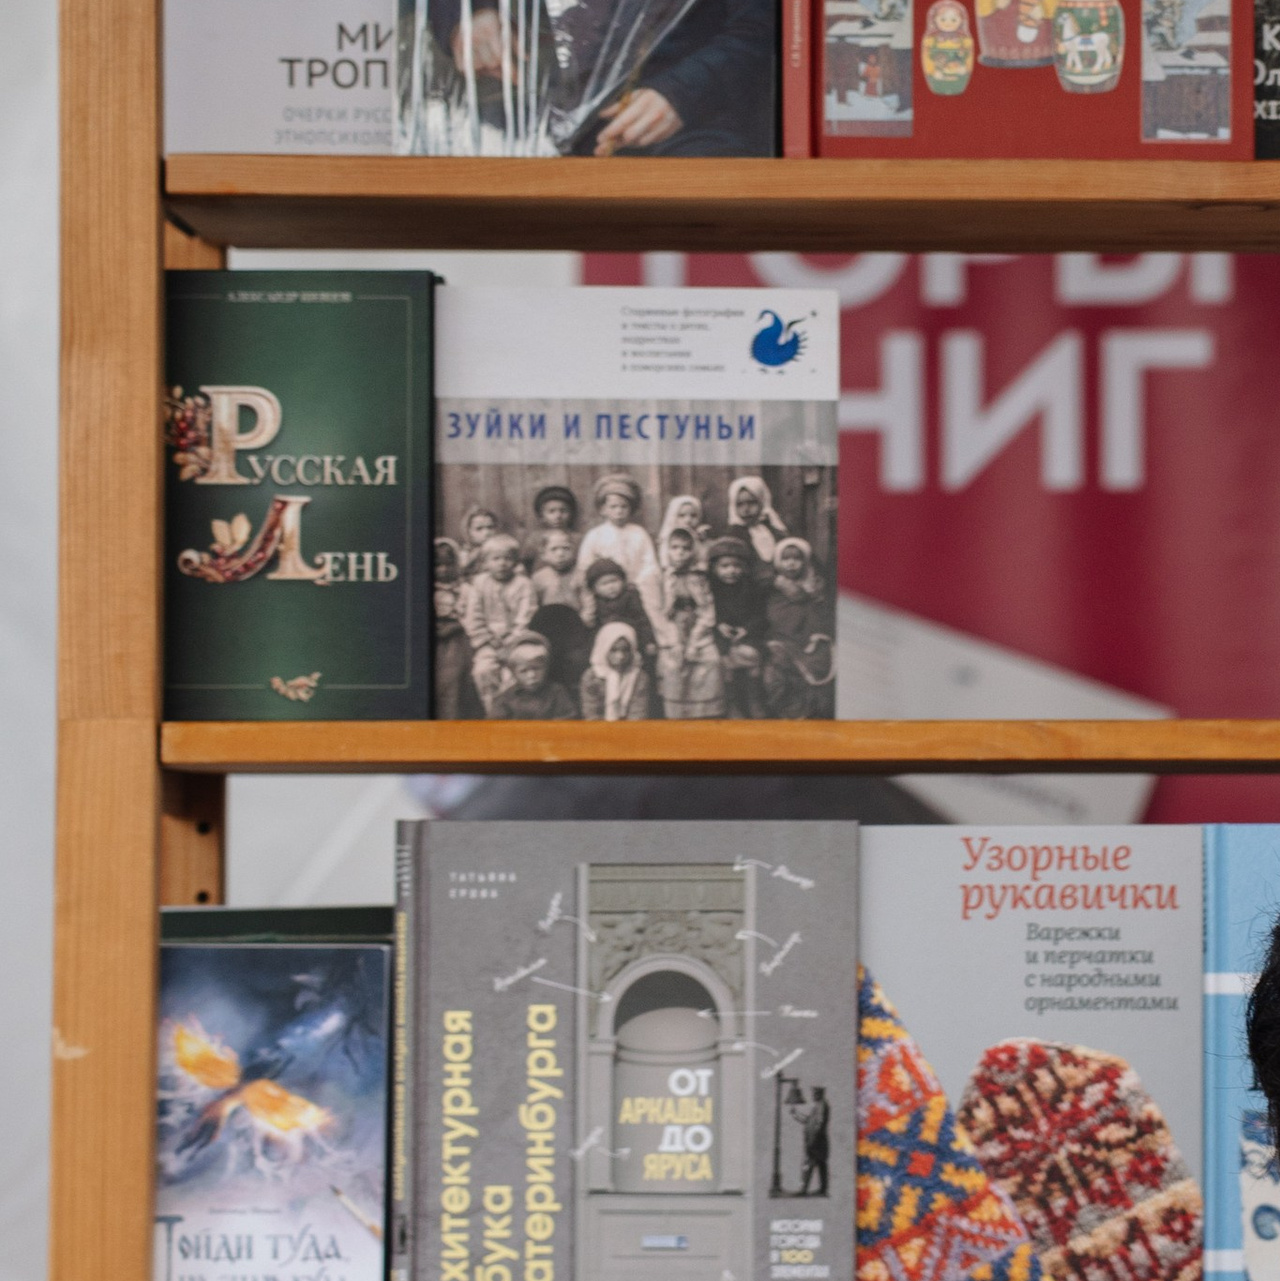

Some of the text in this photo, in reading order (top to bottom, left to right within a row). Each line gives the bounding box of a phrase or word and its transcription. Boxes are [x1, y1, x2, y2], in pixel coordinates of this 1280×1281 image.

[279, 58, 389, 89] ТРОП
[447, 407, 756, 441] ЗУЙКИ И ПЕСТУНЬИ
[960, 836, 1133, 881] Узорные
[960, 881, 1179, 920] рукавички
[1025, 923, 1121, 943] Варежки
[1026, 948, 1154, 970] и перчатки
[1025, 968, 1161, 991] с народными
[1025, 994, 1179, 1017] орнаментами
[668, 1068, 714, 1096] ОТ
[618, 1096, 714, 1124] АРКАДЫ
[658, 1124, 714, 1153] ДО
[643, 1152, 714, 1181] ЯРУСА
